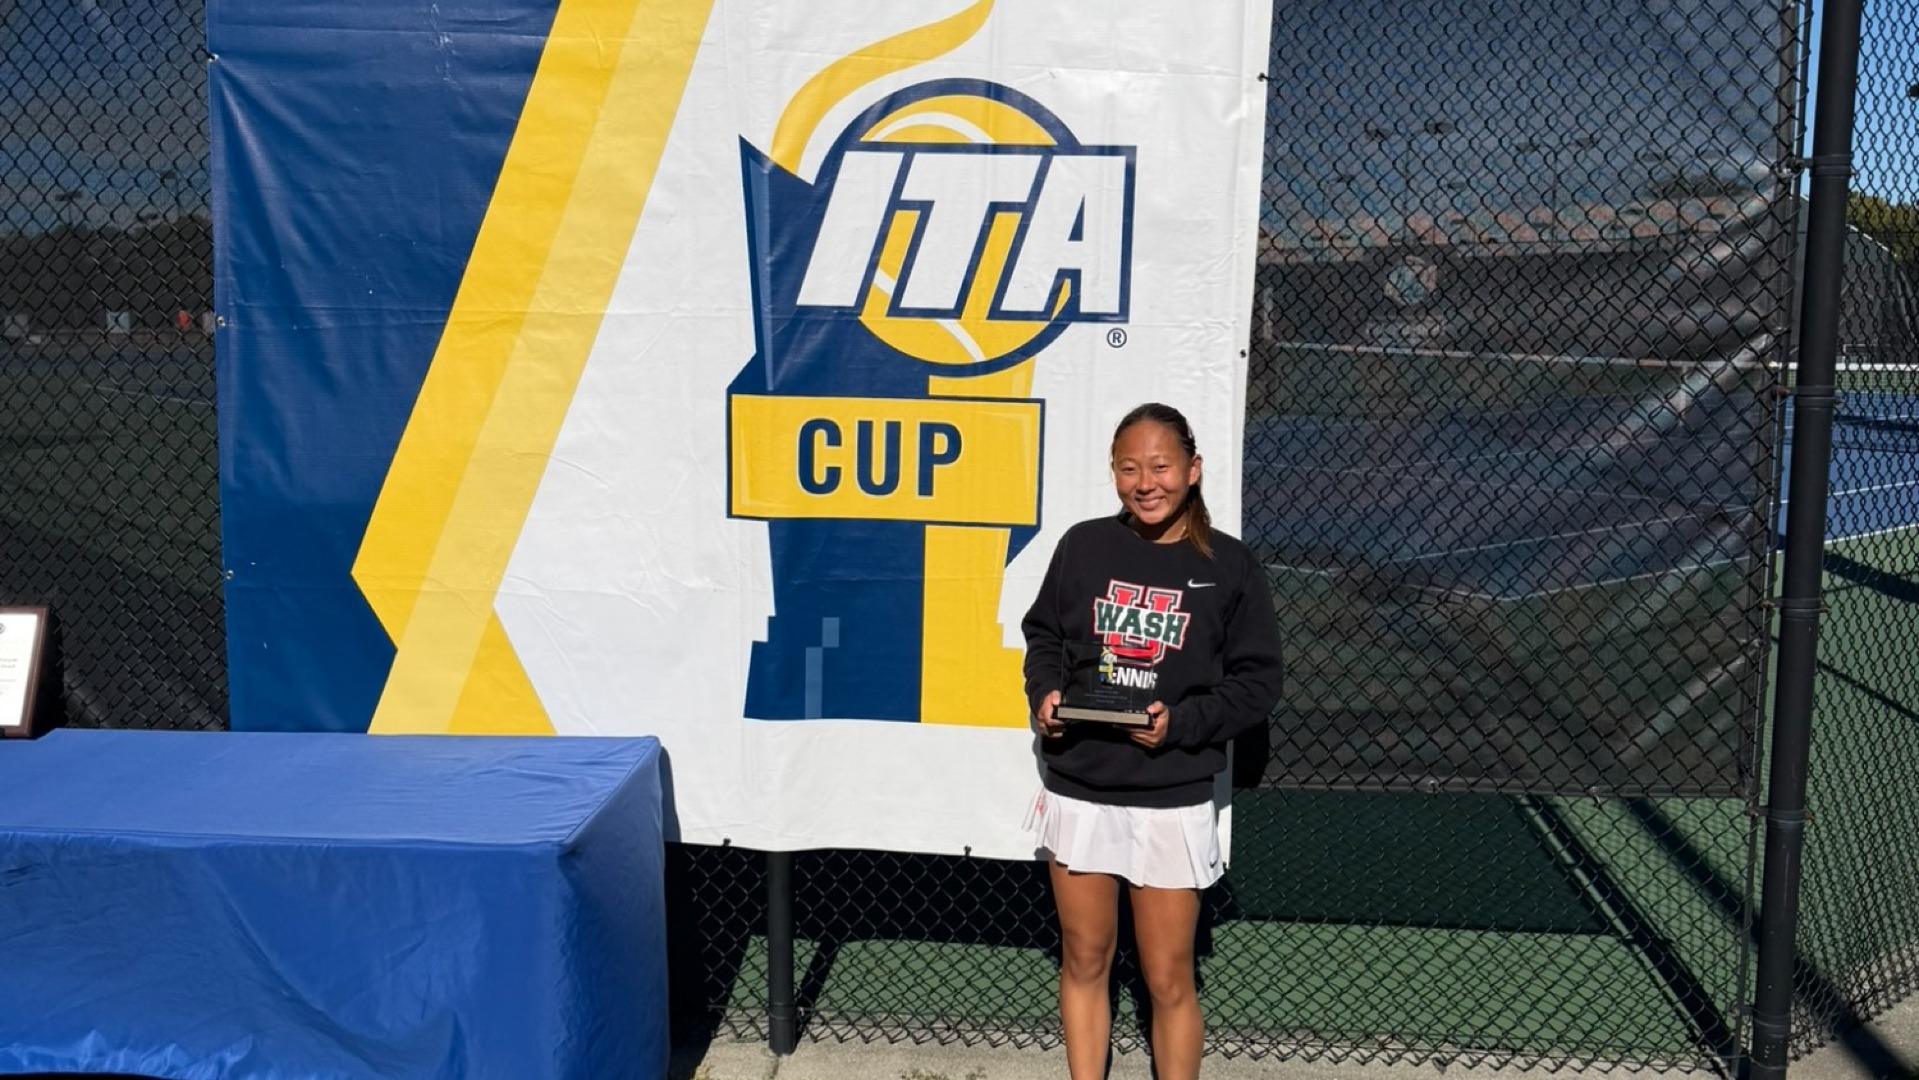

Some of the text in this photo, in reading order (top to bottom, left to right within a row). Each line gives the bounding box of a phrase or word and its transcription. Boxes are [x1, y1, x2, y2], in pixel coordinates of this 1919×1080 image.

[796, 150, 1127, 314] ITA
[798, 418, 962, 498] CUP
[1095, 601, 1188, 647] WASH
[1109, 667, 1158, 690] NNIS
